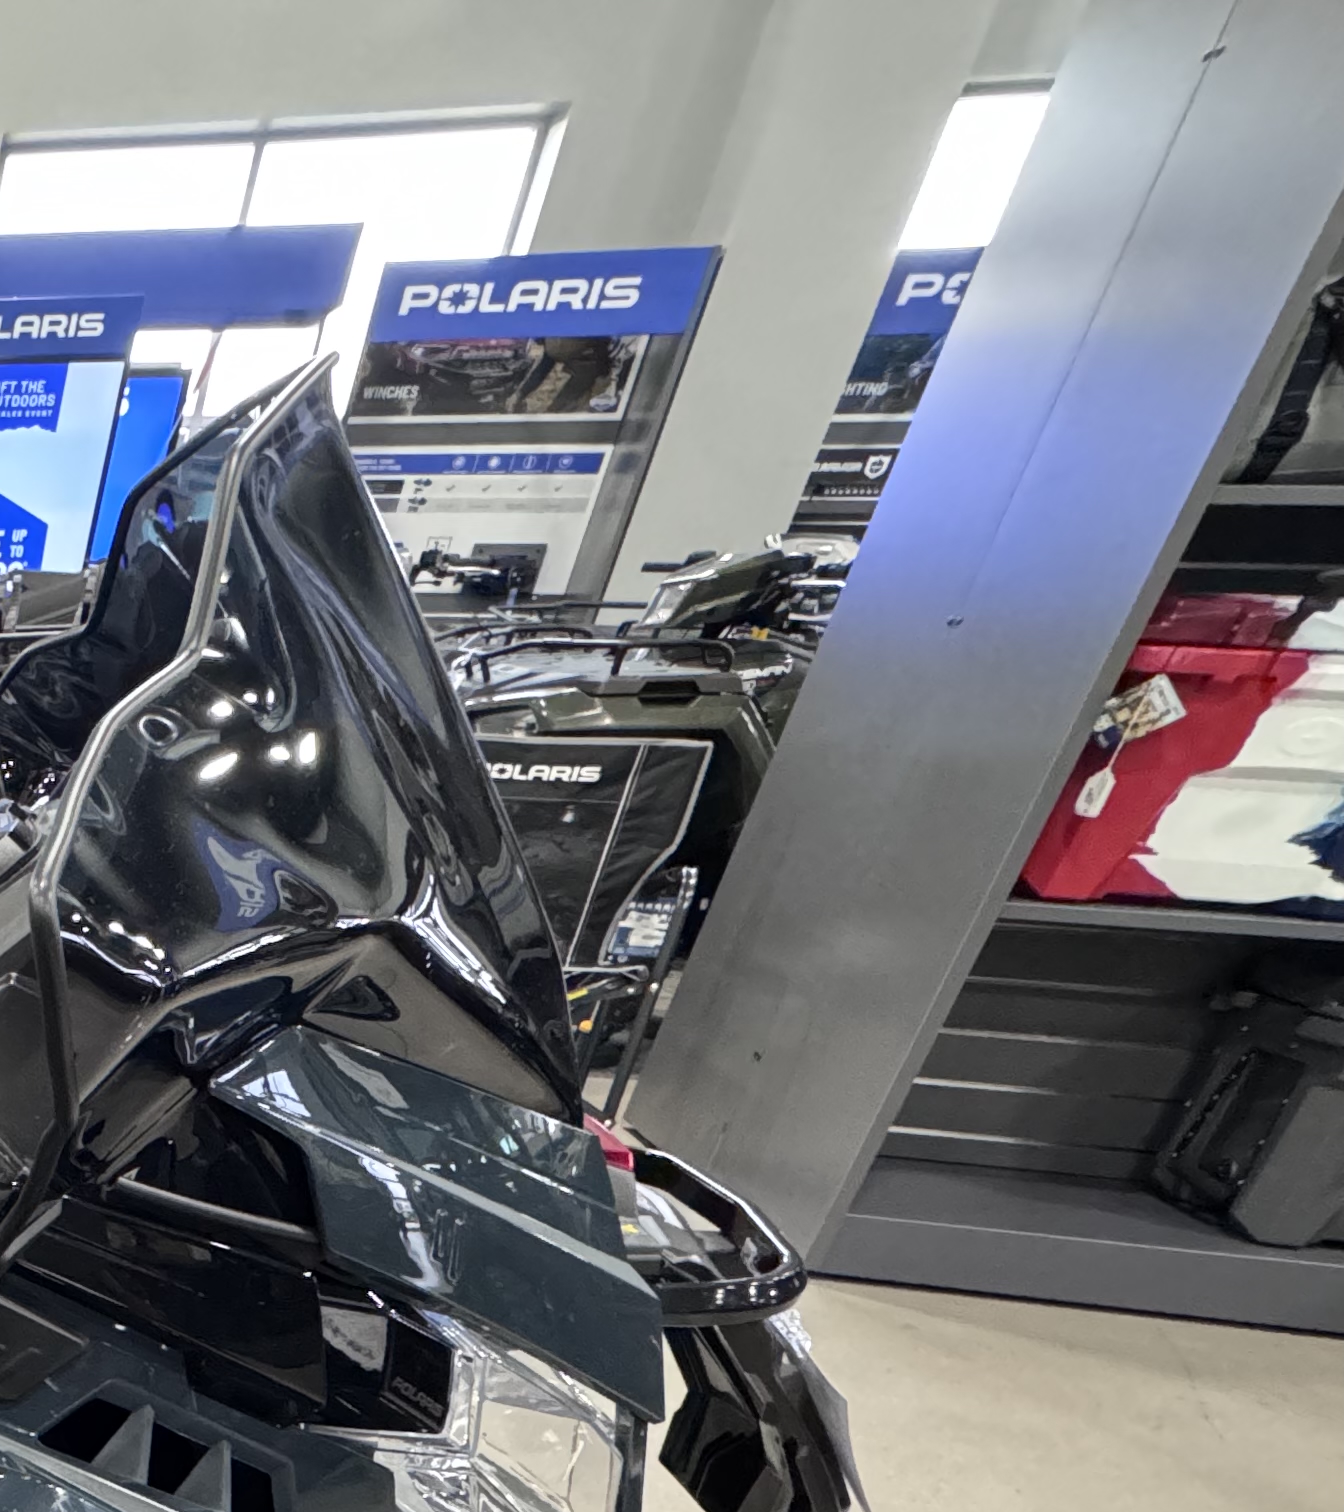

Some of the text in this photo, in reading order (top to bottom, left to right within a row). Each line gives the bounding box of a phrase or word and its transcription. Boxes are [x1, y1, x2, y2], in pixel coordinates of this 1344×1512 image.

[398, 275, 643, 316] POLARIS
[20, 379, 47, 394] THE
[363, 385, 420, 400] WINCHES
[12, 529, 28, 543] UP
[10, 545, 25, 558] TO
